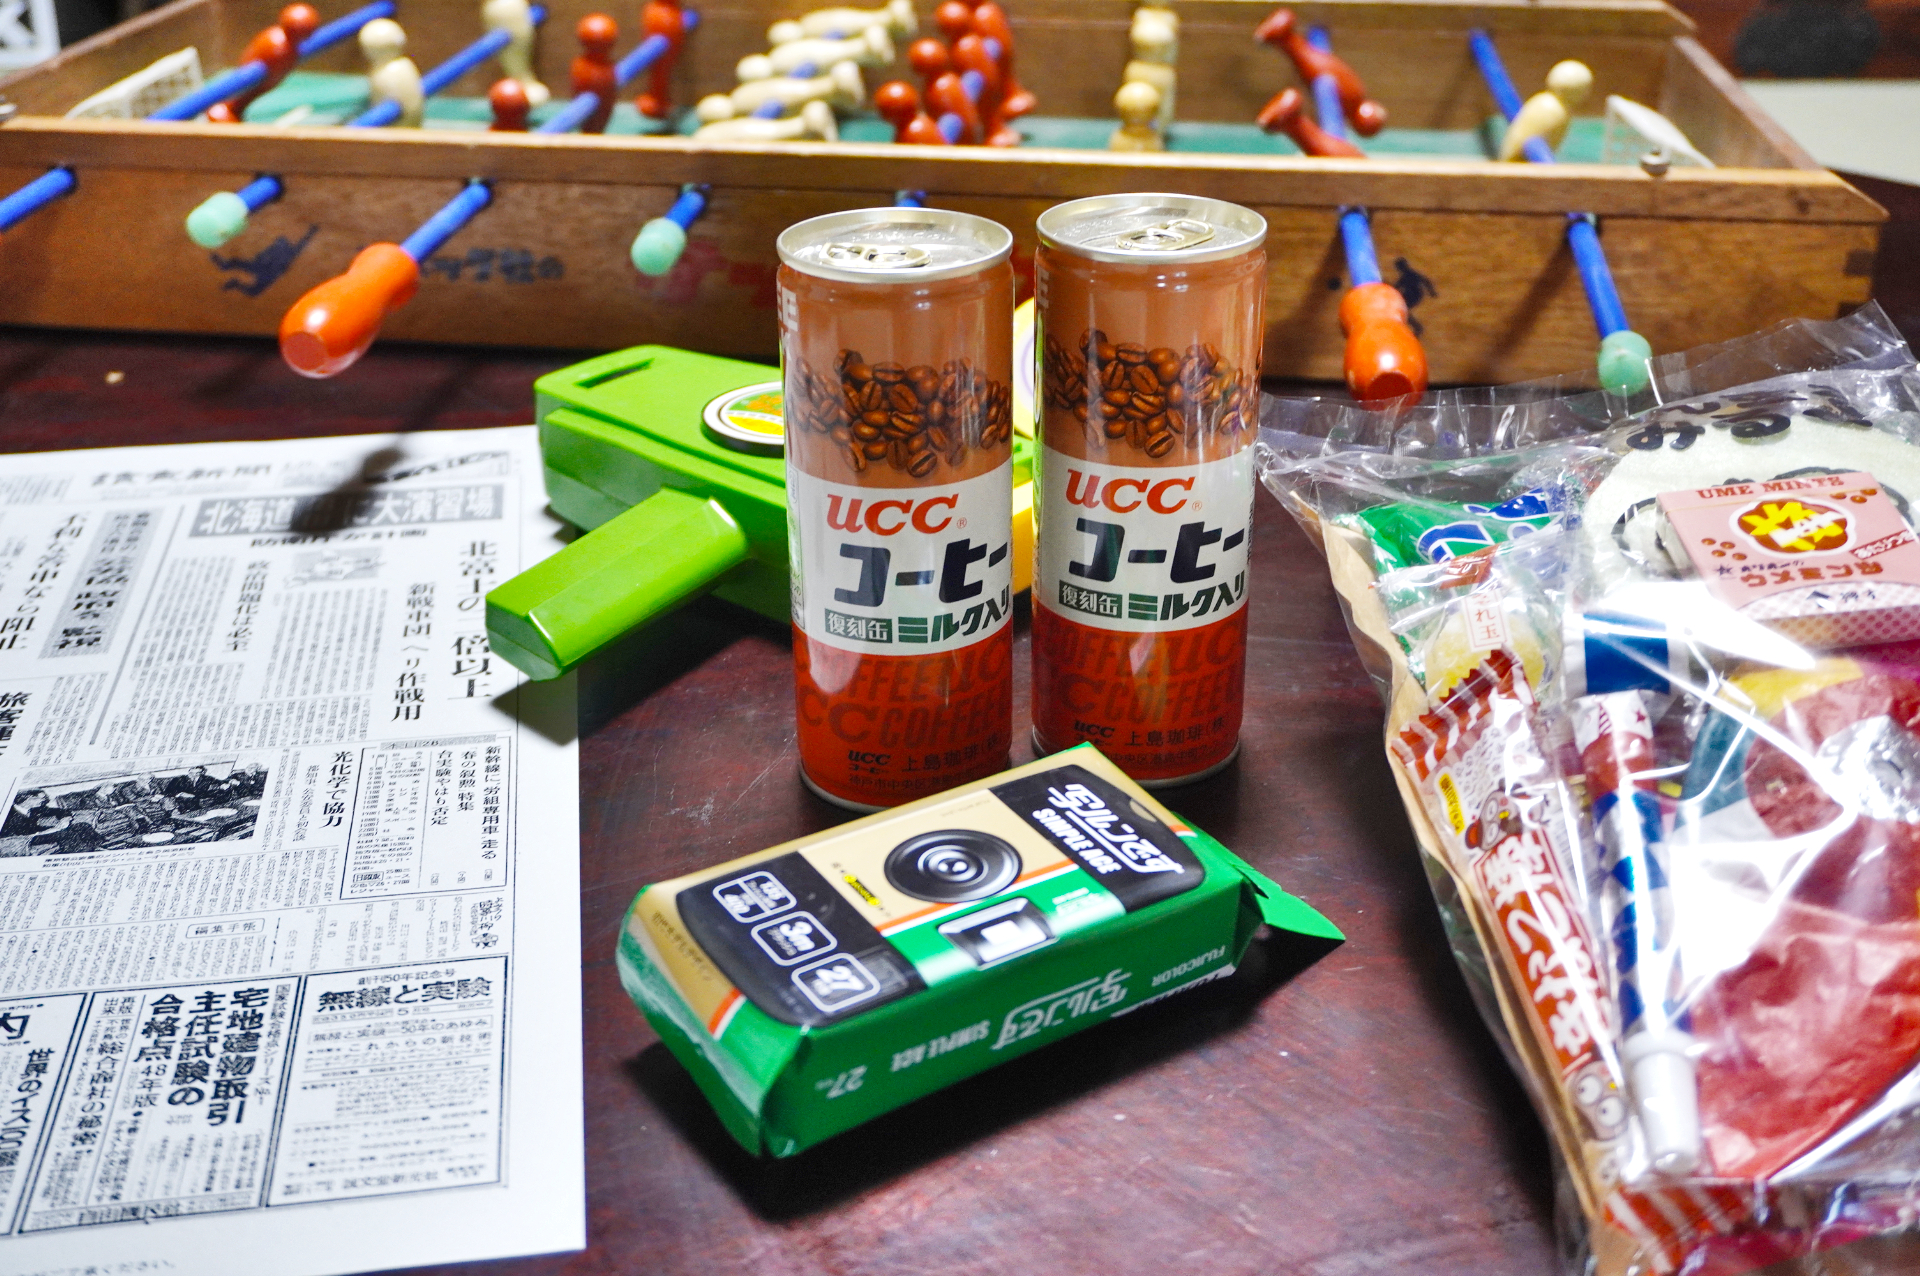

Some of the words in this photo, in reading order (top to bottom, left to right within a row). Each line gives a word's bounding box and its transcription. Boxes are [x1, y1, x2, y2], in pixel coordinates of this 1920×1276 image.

[1066, 468, 1195, 514] UCC
[1696, 485, 1754, 499] UME
[827, 493, 959, 536] UCC
[1068, 517, 1245, 584] コーヒー
[834, 538, 1008, 607] コーヒー
[1061, 584, 1120, 616] 復刻缶
[827, 611, 889, 642] 復刻缶
[318, 751, 354, 829] 光化学で協力
[1032, 808, 1092, 852] SIMPLE
[1080, 845, 1122, 876] ACE
[195, 921, 257, 935] 編集手帳
[778, 912, 816, 953] 3m
[357, 968, 456, 986] 創刊50年記念号
[816, 960, 865, 991] 27
[1151, 945, 1226, 987] FUJICOLOR
[317, 977, 493, 1012] 無線と実験
[133, 993, 184, 1063] 合格点
[167, 990, 226, 1106] 主任試験の
[929, 1019, 990, 1059] SIMPLE
[206, 987, 270, 1127] 宅地建物取引
[888, 1043, 928, 1073] ACE
[826, 1064, 867, 1099] 27
